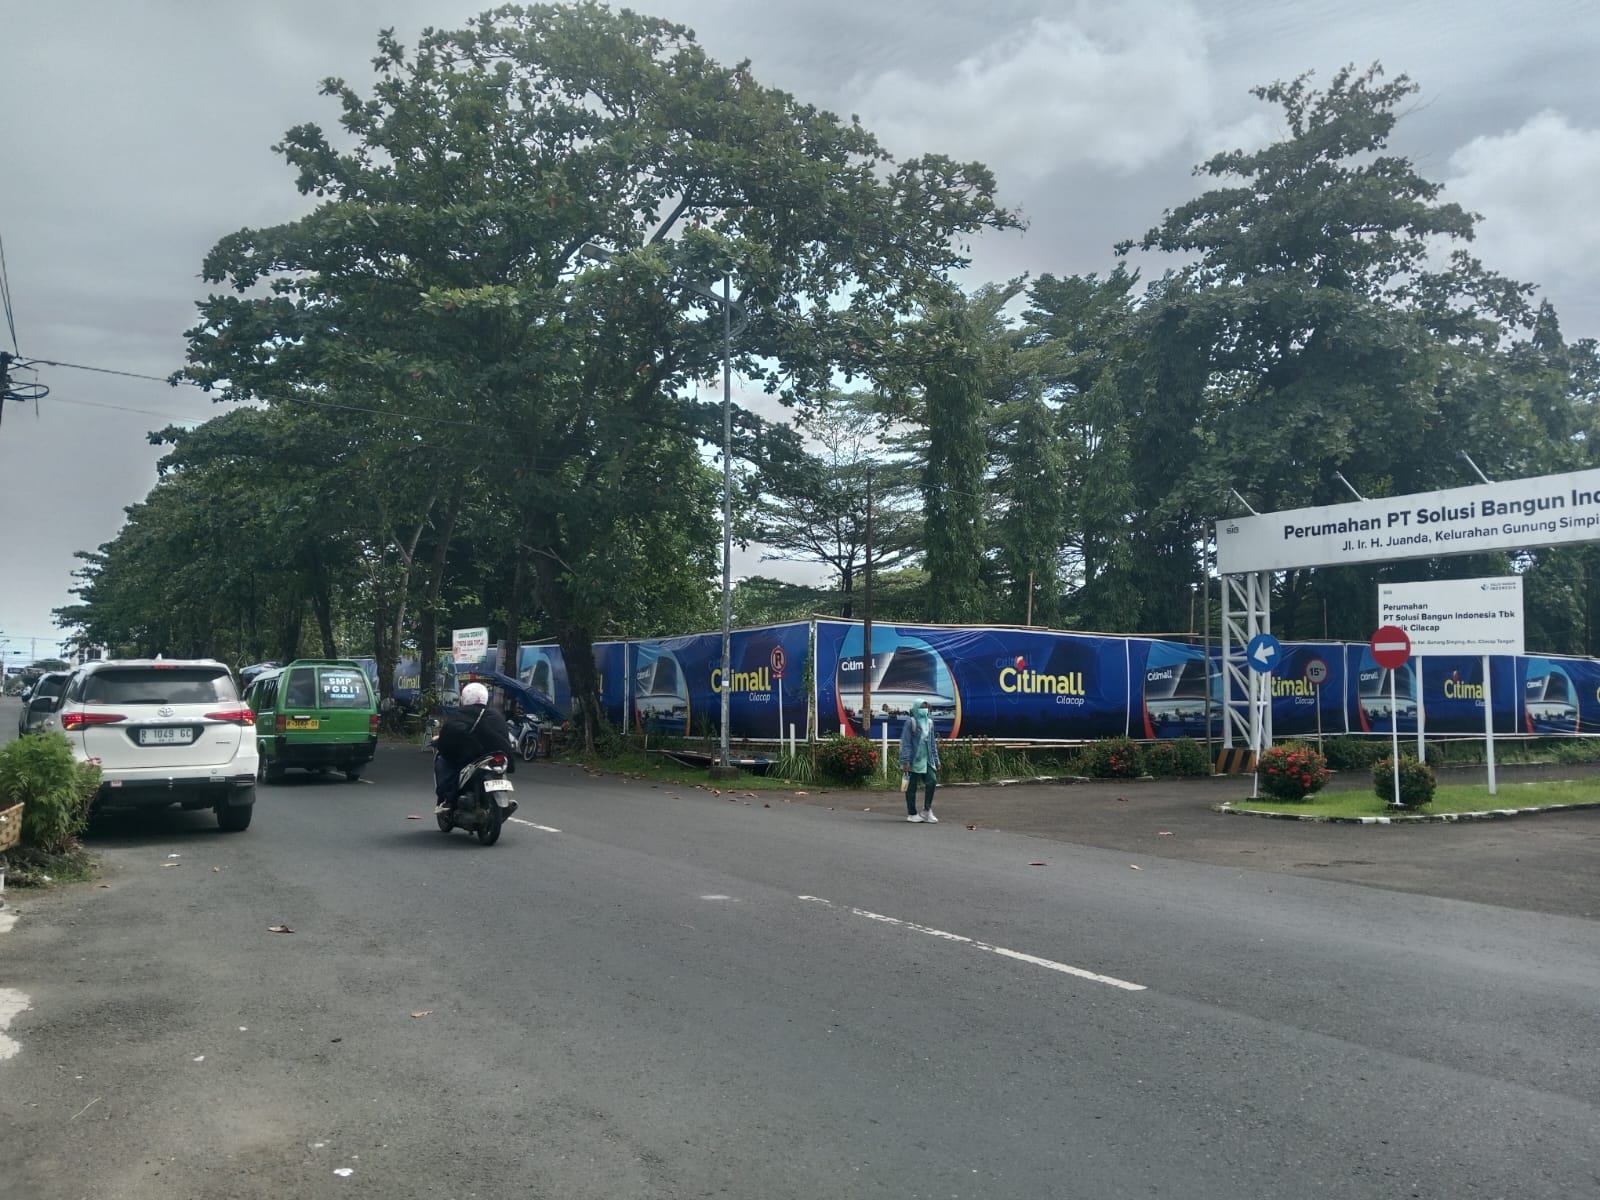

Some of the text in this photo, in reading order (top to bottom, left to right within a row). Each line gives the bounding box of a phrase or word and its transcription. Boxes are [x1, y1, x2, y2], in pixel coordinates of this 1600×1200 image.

[1284, 517, 1381, 540] Perumahan
[1388, 511, 1411, 528] PT
[1417, 502, 1475, 524] Solusi
[1481, 495, 1565, 516] Bangun
[1342, 540, 1354, 552] Jl.
[1357, 539, 1368, 550] Ir.
[1371, 538, 1383, 548] H.
[1386, 533, 1432, 547] Juanda,
[1435, 526, 1498, 541] Kelurahan
[1502, 520, 1556, 533] Gunung
[1383, 602, 1428, 611] Perumahan
[1421, 613, 1453, 621] Bangun
[1455, 611, 1496, 619] Indonesia
[1499, 610, 1515, 618] Tbk
[1410, 624, 1440, 632] Cilacap
[841, 658, 876, 671] Citiml
[1310, 667, 1320, 676] 15
[329, 677, 351, 685] SMP
[711, 666, 772, 693] Cimall
[999, 667, 1085, 695] Citimall
[1271, 675, 1315, 696] timall
[1056, 695, 1085, 707] Cilacap
[141, 729, 191, 738] R 1049 GC
